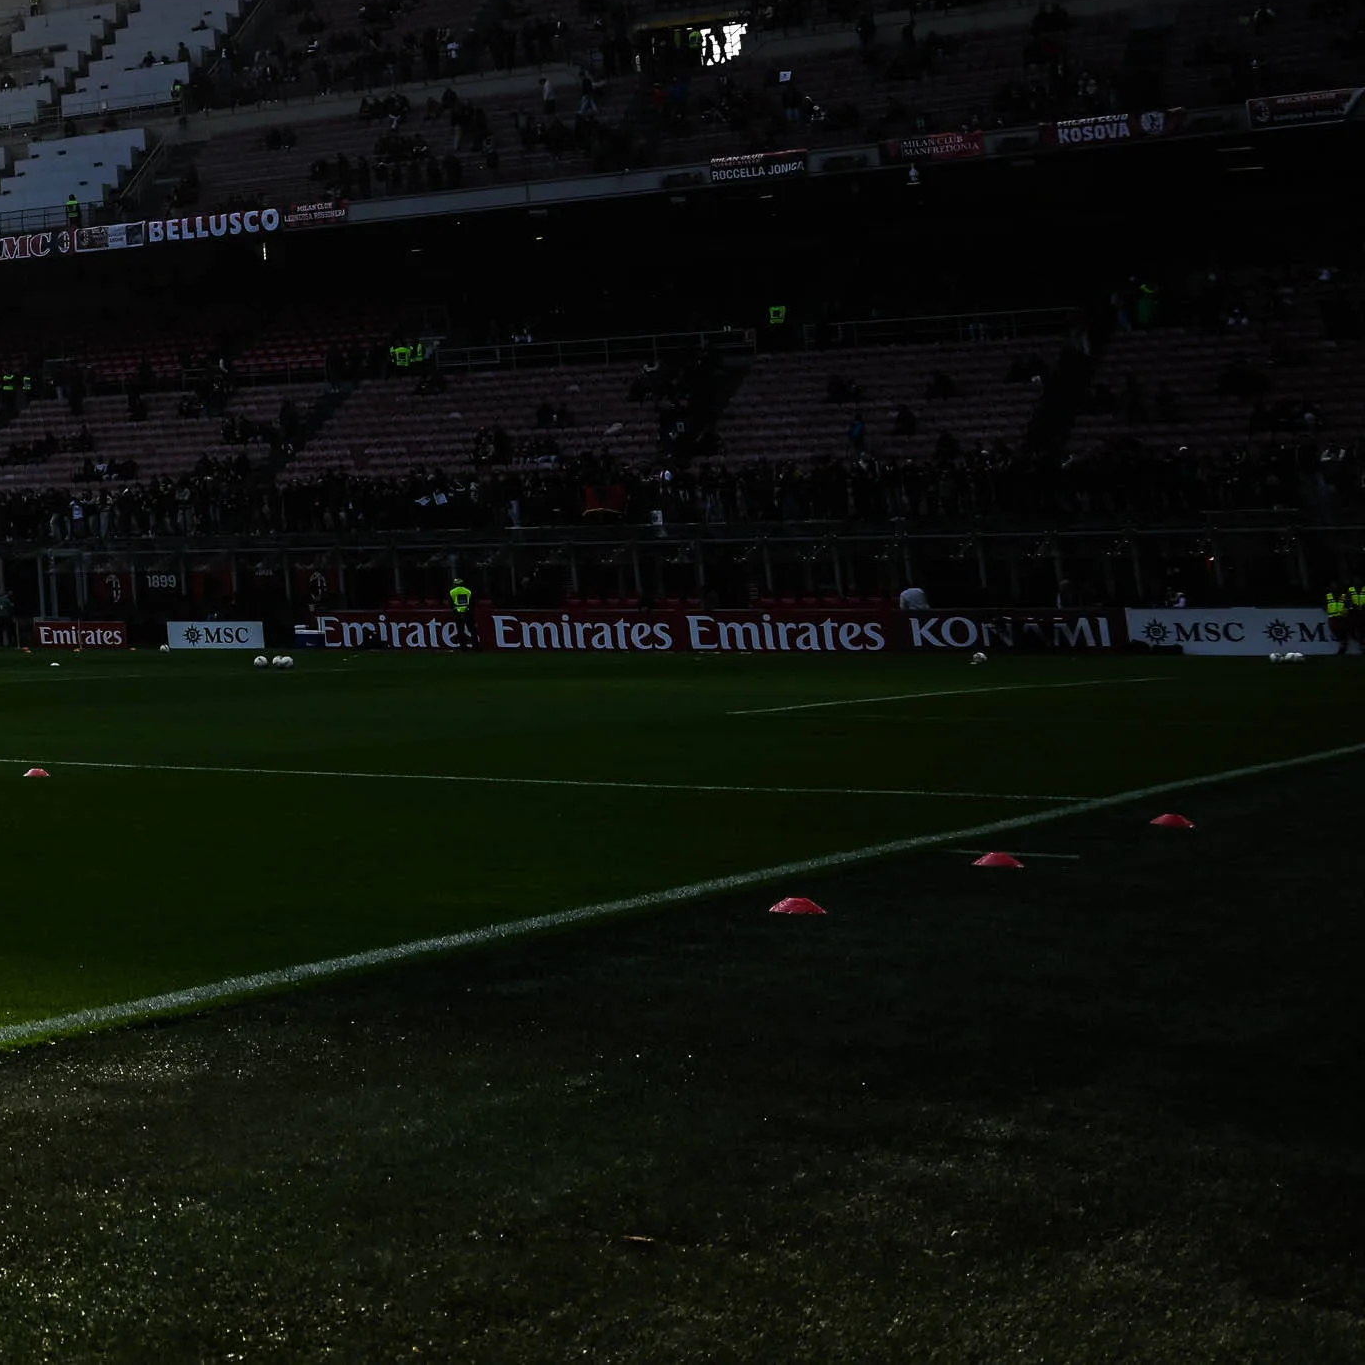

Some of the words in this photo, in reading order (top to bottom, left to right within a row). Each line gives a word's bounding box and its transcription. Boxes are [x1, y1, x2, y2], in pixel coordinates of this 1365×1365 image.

[1057, 122, 1130, 144] KOSOVA
[903, 142, 979, 155] MANFREDONIA
[711, 166, 765, 181] ROCCELLA
[768, 160, 804, 176] JONICA
[149, 209, 280, 242] BELLUSCO
[146, 575, 176, 588] 1899
[39, 625, 123, 646] Emirates
[203, 627, 249, 644] MSC
[491, 613, 672, 650] Emirates
[685, 613, 886, 651] Emirates
[1173, 622, 1245, 642] MSC
